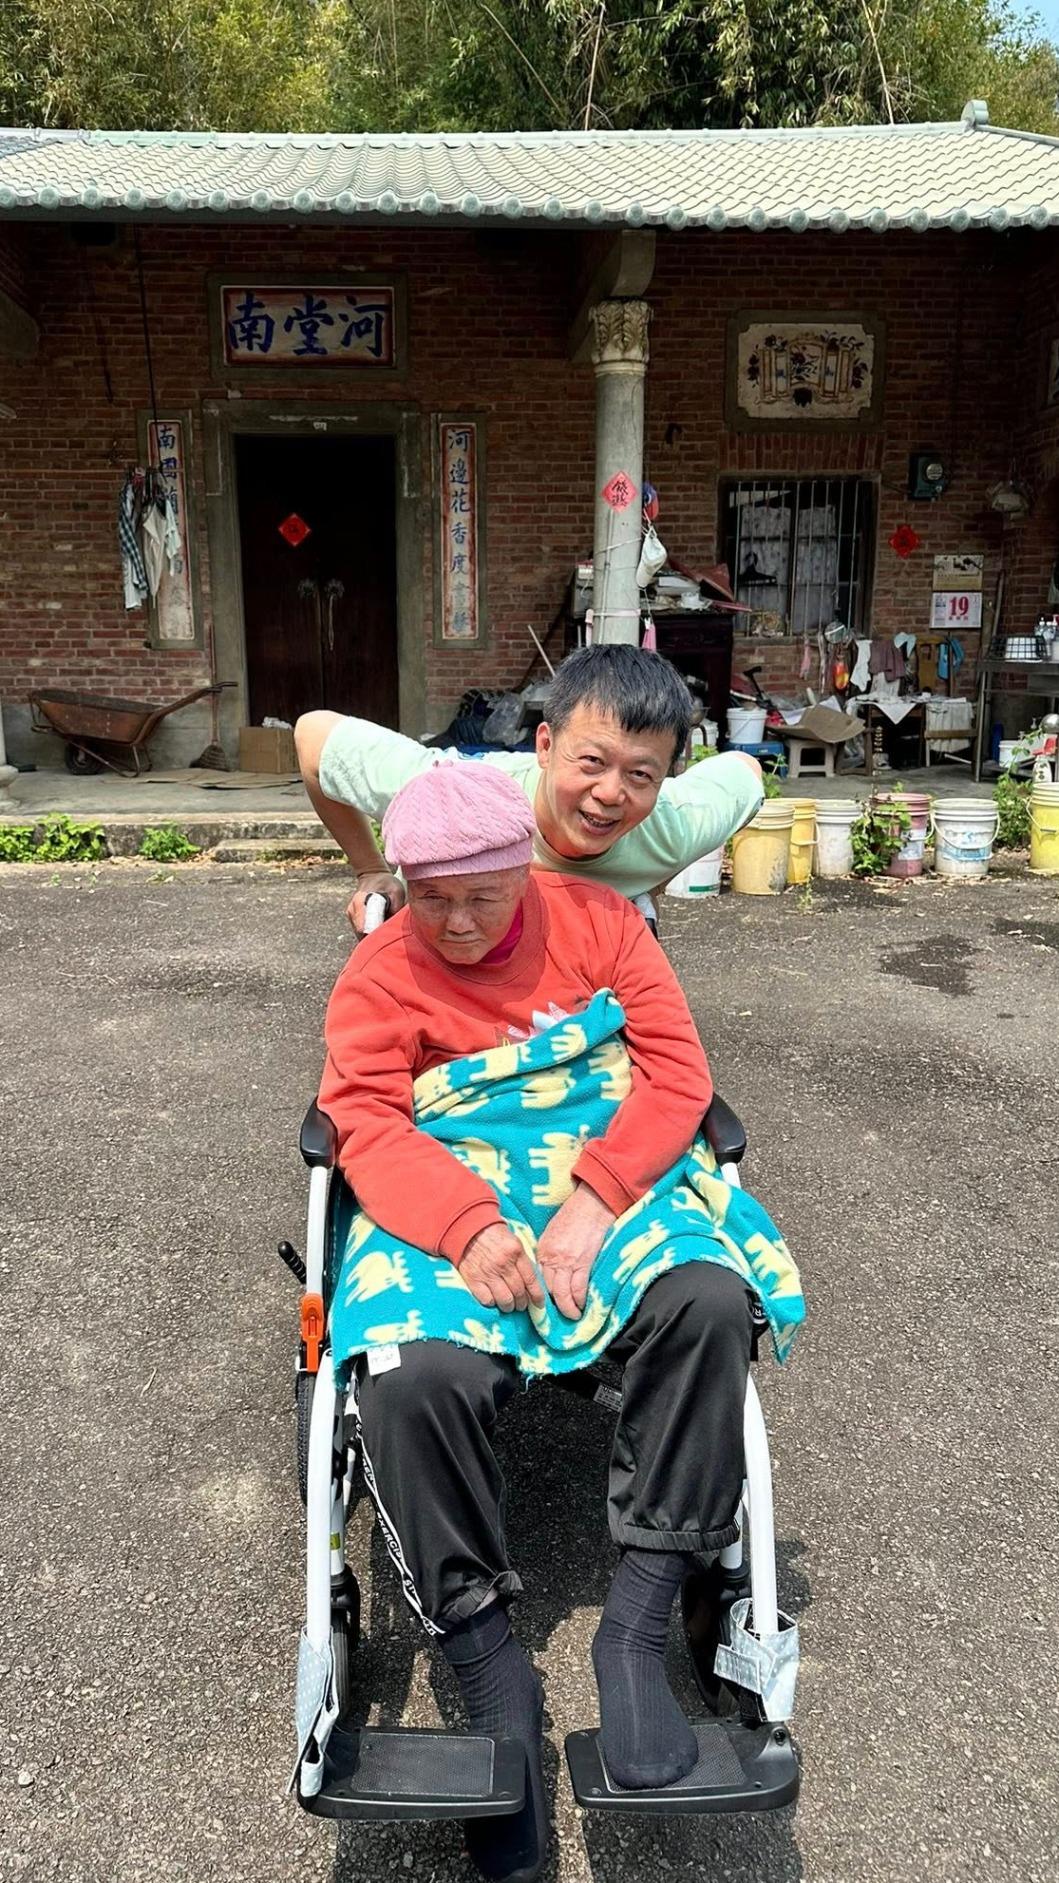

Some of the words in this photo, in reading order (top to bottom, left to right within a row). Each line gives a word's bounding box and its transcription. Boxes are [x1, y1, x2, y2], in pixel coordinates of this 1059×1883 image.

[448, 428, 471, 633] 河邊花香度
[949, 596, 969, 616] 19
